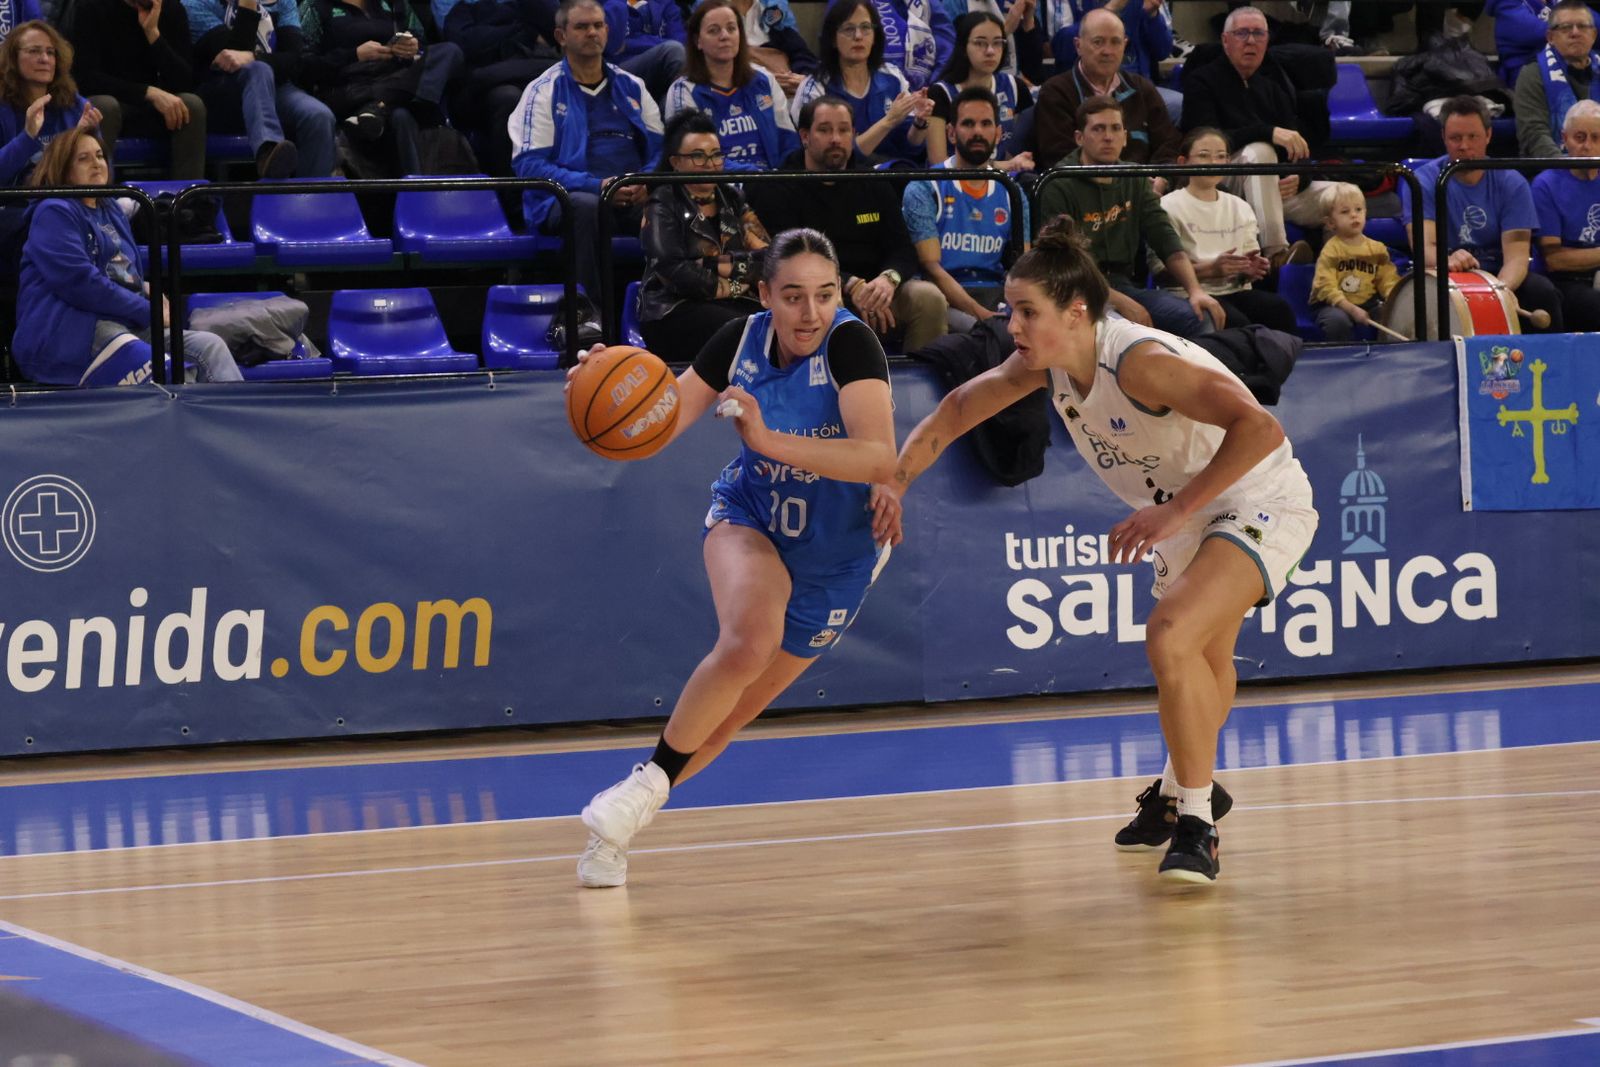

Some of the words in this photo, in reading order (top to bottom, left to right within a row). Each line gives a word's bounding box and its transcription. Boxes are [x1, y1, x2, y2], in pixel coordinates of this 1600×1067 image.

[941, 231, 1003, 254] AVENIDA
[767, 489, 807, 538] 10
[0, 587, 494, 693] enida.com
